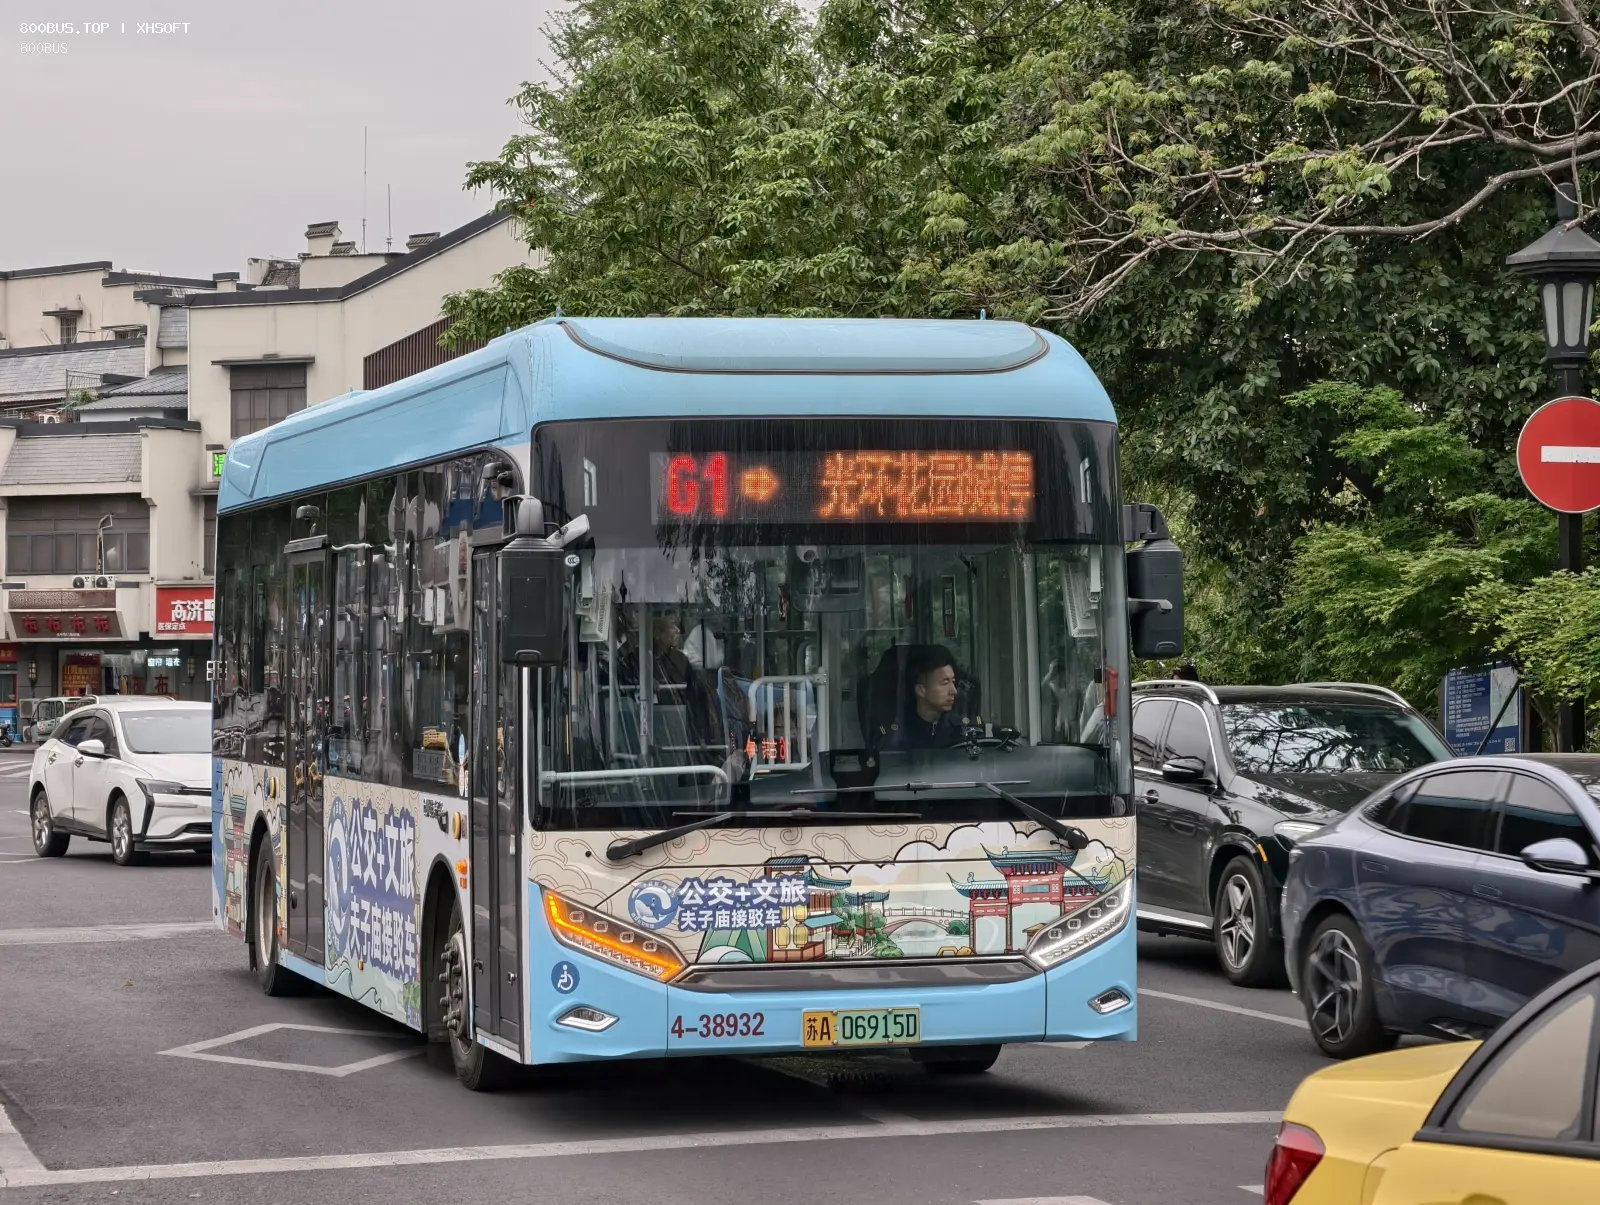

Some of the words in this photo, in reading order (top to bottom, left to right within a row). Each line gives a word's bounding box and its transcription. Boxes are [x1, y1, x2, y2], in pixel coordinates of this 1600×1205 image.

[667, 453, 729, 515] G1
[157, 621, 186, 631] 医保定点
[348, 804, 416, 898] 公交+文旅
[678, 876, 808, 907] 公交+文旅
[680, 907, 782, 930] 夫子庙接驳车
[348, 897, 417, 978] 夫子庙接驳车
[670, 1012, 765, 1039] 4-38932
[840, 1012, 918, 1040] 06915D
